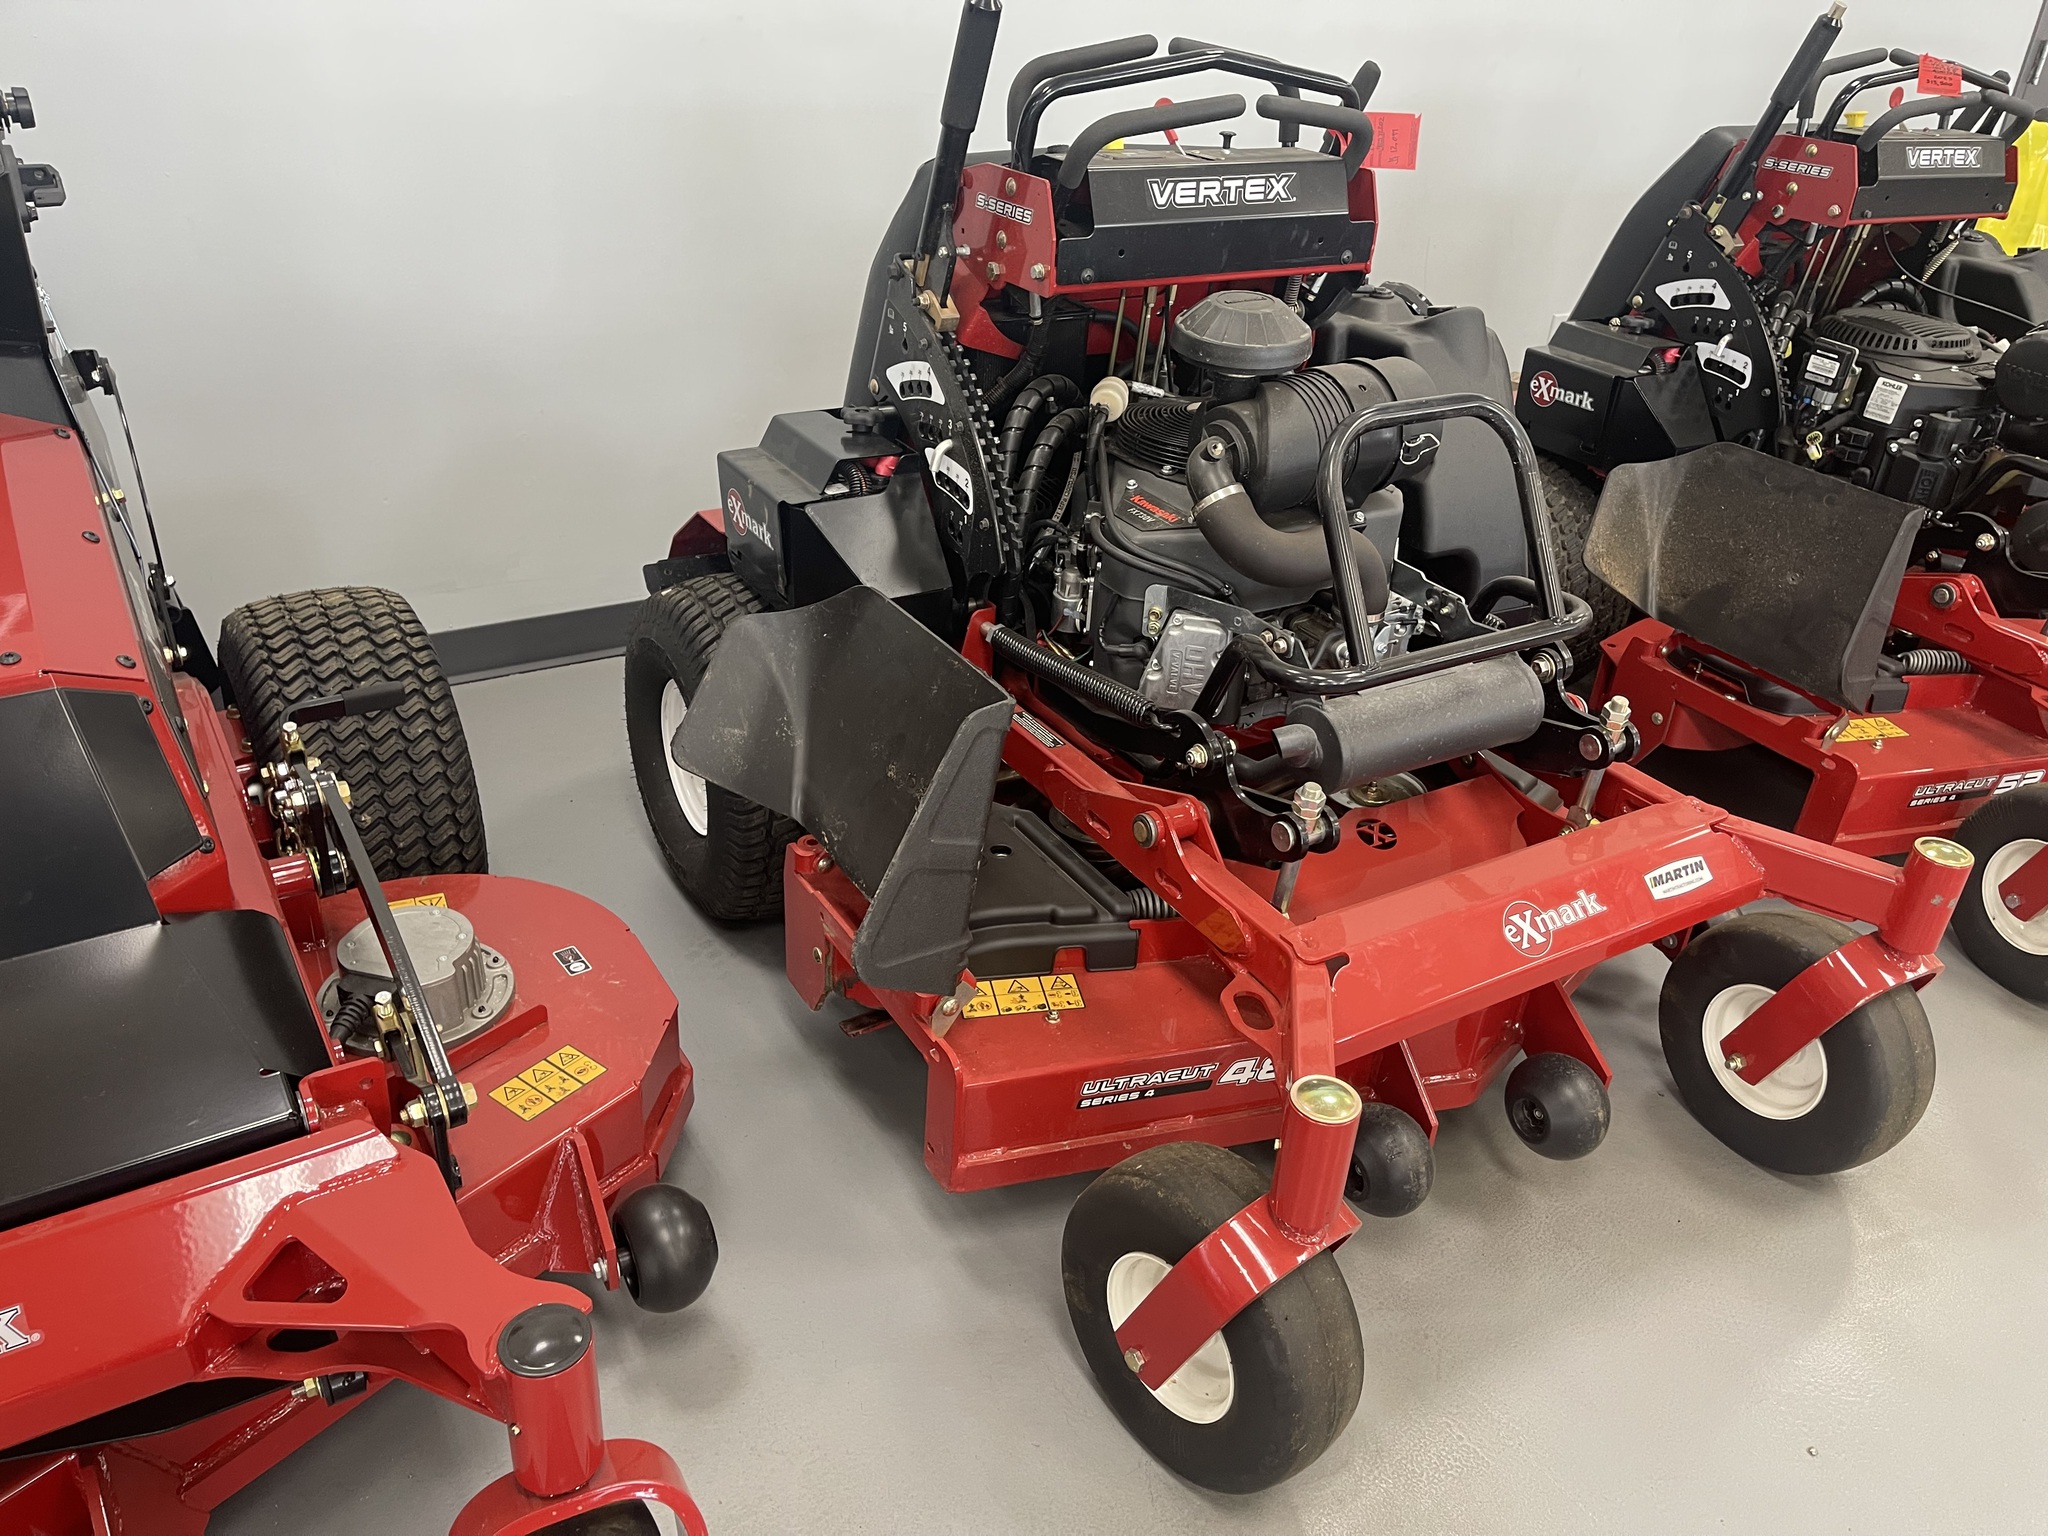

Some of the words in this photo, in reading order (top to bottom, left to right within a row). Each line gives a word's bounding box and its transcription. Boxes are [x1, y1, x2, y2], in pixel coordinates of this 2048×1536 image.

[1906, 147, 1981, 168] VERTEX
[1762, 157, 1834, 178] S-SERIES
[1147, 173, 1297, 209] VERTEX
[976, 192, 1033, 225] S-SERIES
[1686, 250, 1693, 259] 5
[1711, 282, 1717, 290] 4
[902, 321, 908, 333] 5
[1730, 319, 1737, 328] 3
[1742, 361, 1749, 370] 2
[1881, 381, 1903, 391] KOHLER
[947, 418, 953, 430] 3
[963, 478, 970, 489] 2
[1129, 494, 1181, 524] Kawasaki
[1913, 775, 2000, 798] ULTRACUT
[1909, 795, 1948, 807] SERIES
[1650, 860, 1704, 888] MARTIN
[1081, 1063, 1219, 1096] ULTRACUT
[1080, 1091, 1140, 1108] SERIES
[1144, 1089, 1155, 1098] 4
